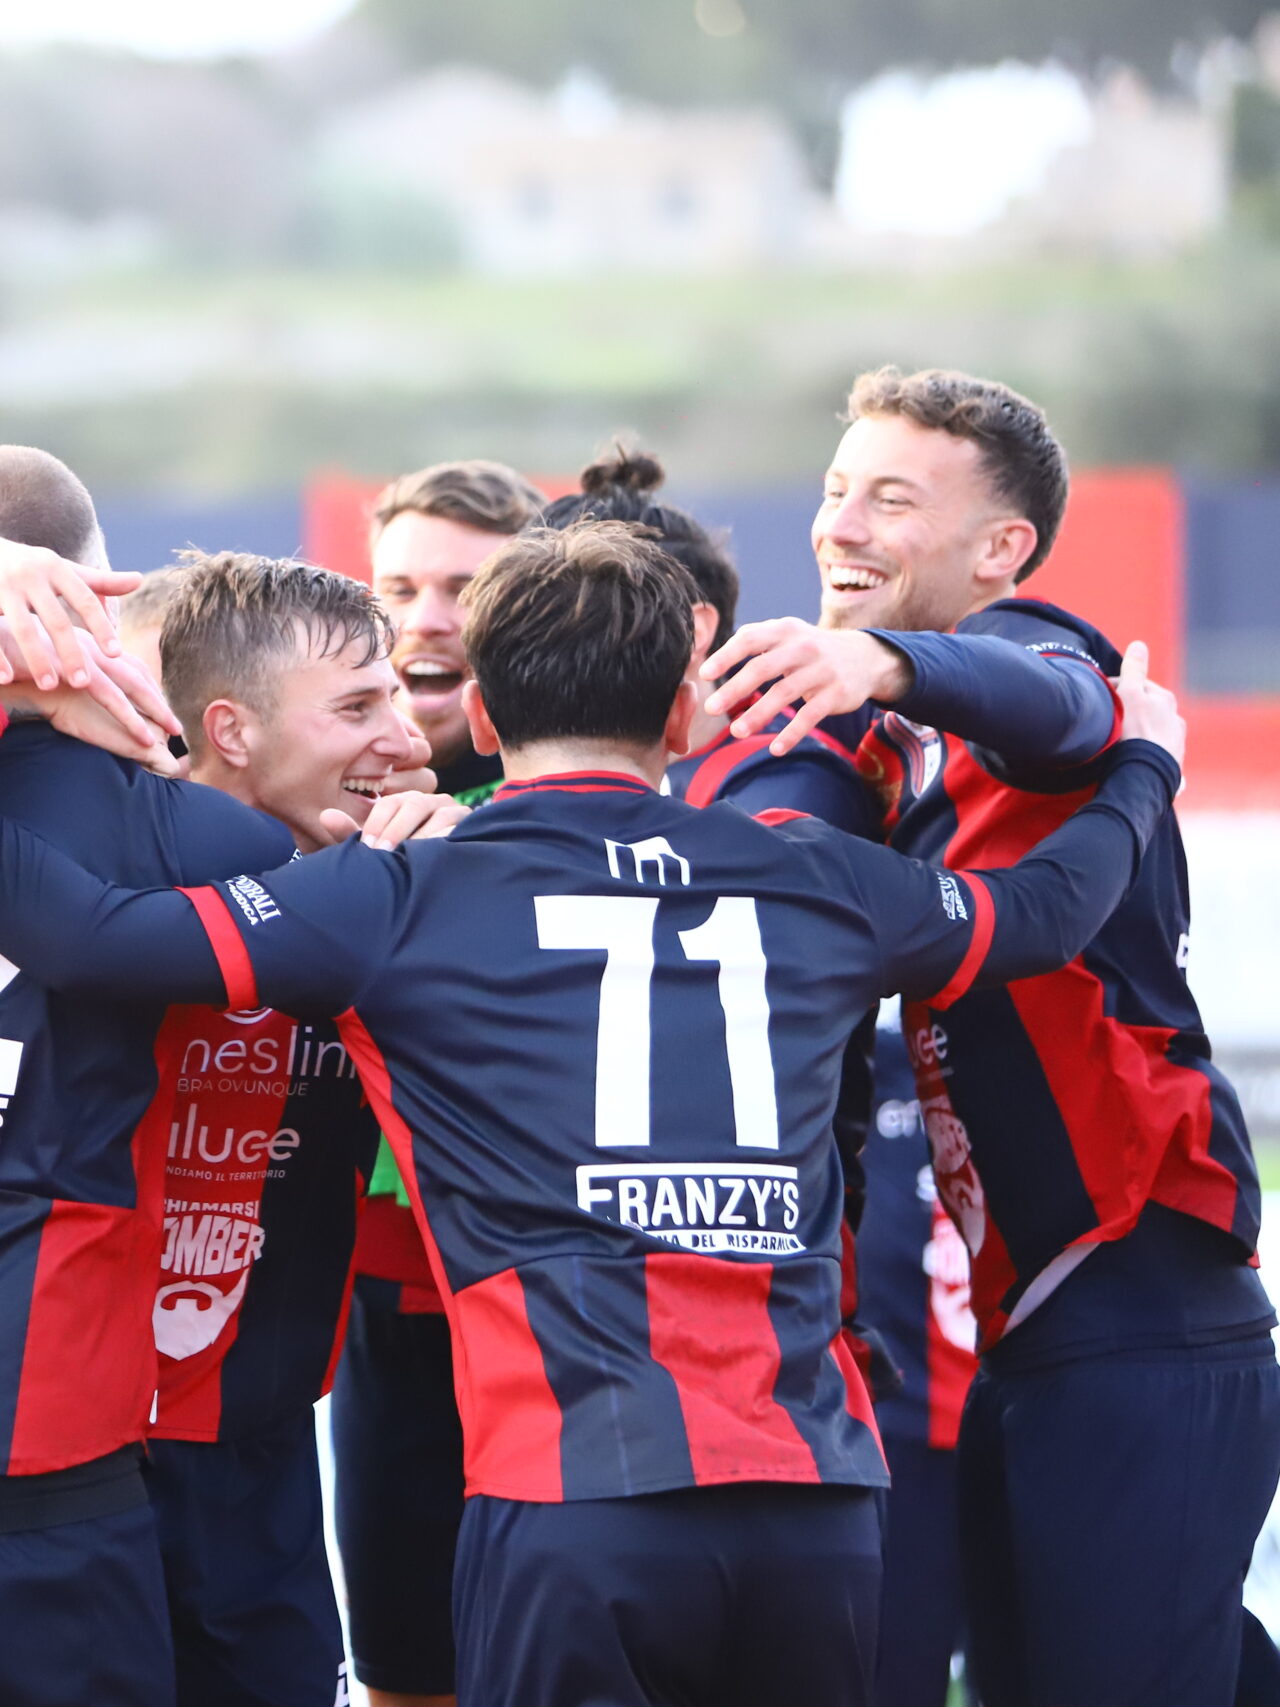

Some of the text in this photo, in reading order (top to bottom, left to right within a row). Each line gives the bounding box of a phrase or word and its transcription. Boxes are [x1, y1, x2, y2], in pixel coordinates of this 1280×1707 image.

[533, 896, 779, 1150] 71
[218, 1078, 310, 1098] OVUNQUE
[228, 1169, 287, 1182] TERRITORIO
[576, 1162, 801, 1231] FRANZY'S
[163, 1198, 260, 1220] HIAMARSI
[691, 1234, 717, 1249] DEL
